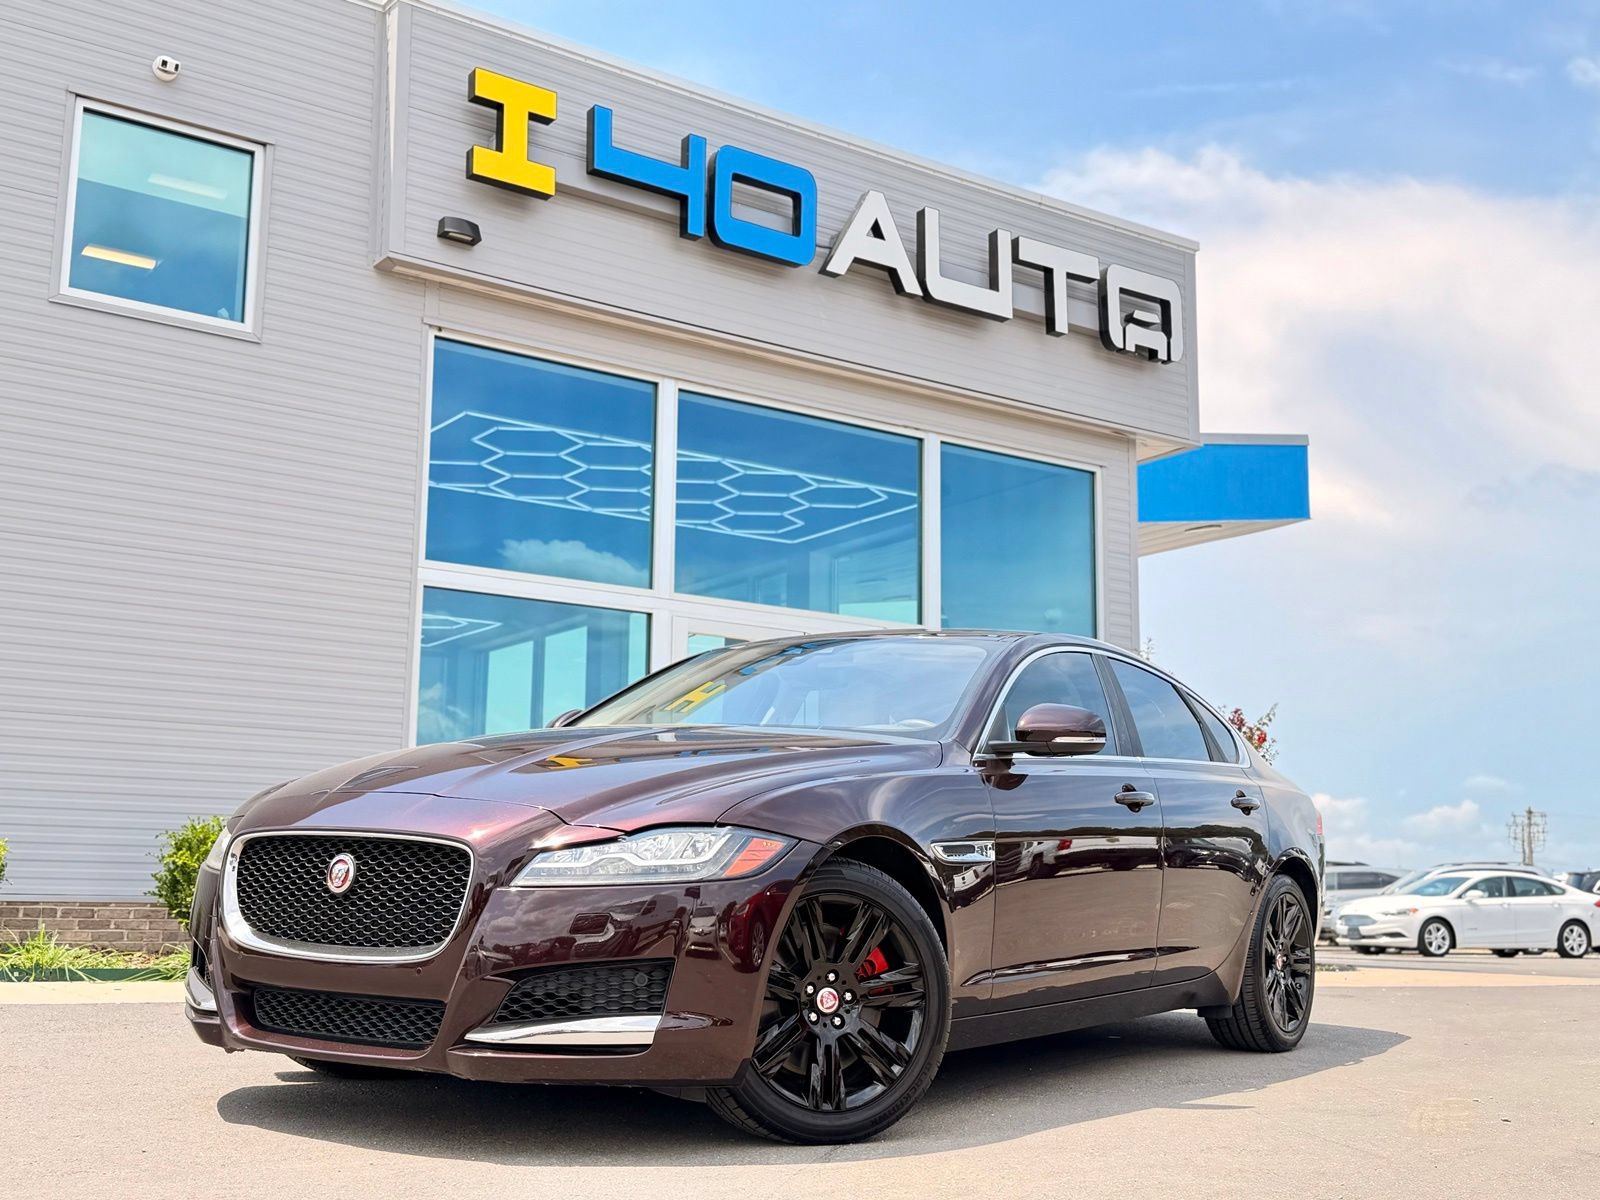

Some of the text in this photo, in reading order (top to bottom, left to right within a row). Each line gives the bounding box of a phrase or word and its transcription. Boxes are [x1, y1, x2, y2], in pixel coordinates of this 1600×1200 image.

[467, 67, 1184, 364] I 40 AUTO
